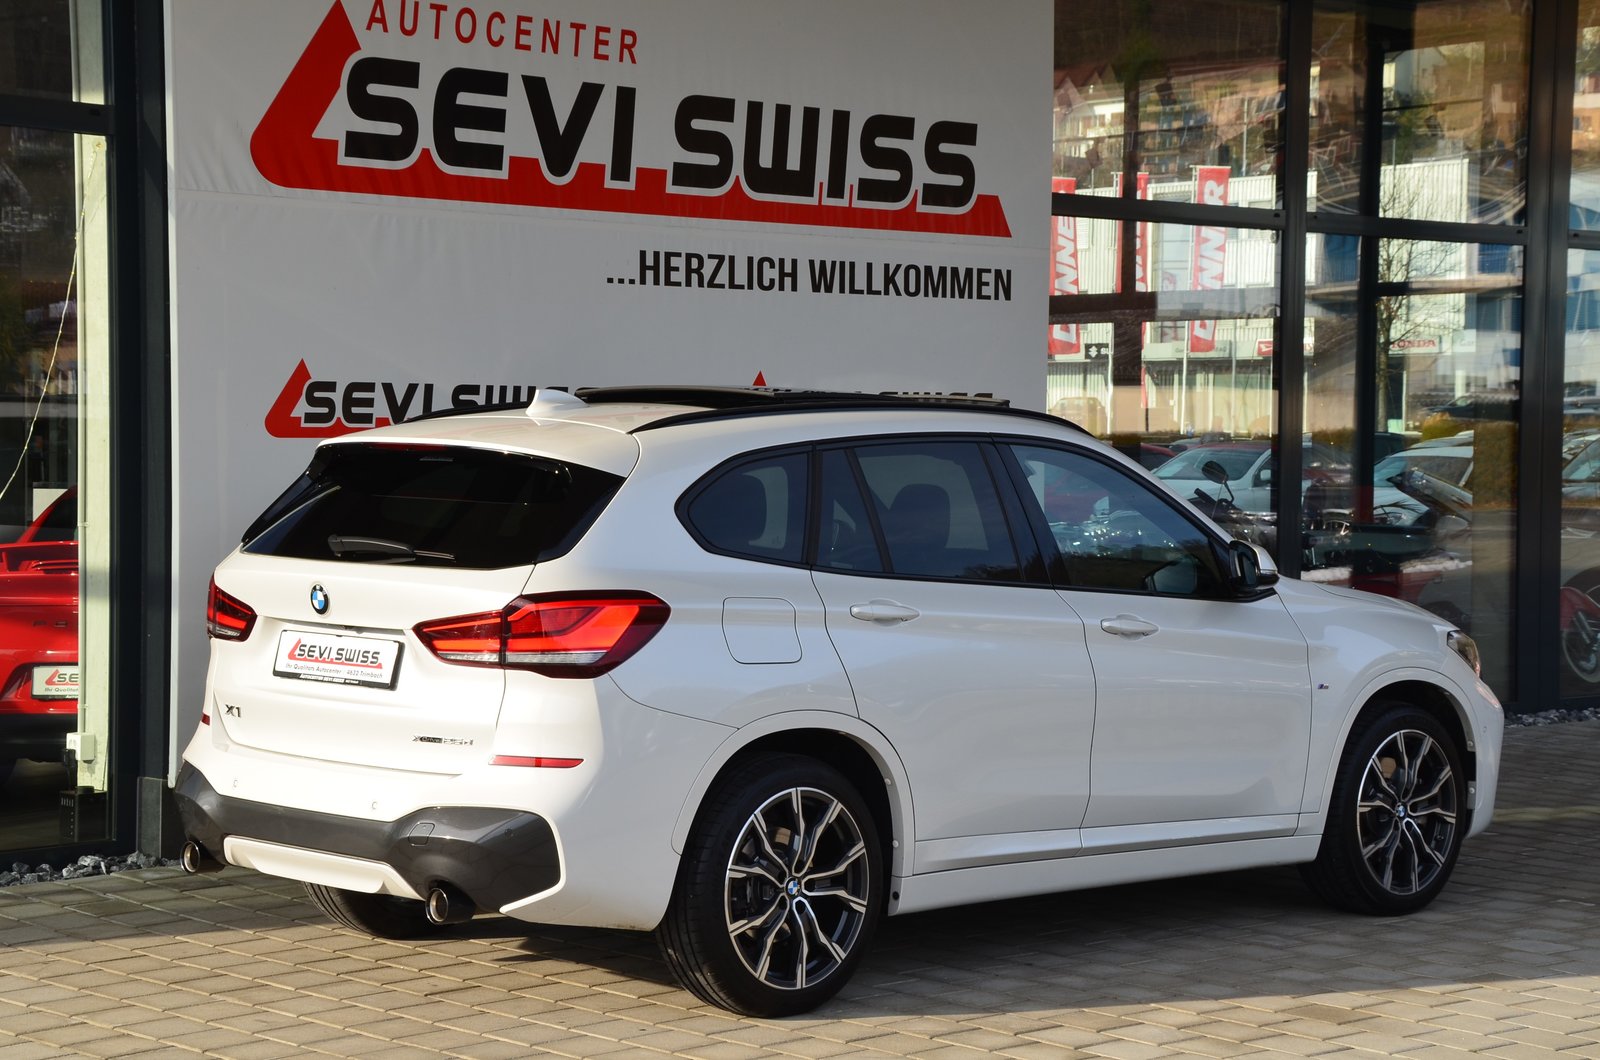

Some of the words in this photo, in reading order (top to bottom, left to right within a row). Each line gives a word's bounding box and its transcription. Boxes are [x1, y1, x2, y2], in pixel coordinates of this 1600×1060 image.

[366, 0, 637, 64] AUTOCENTER
[345, 57, 636, 183] SEVI
[672, 94, 978, 208] SWISS
[606, 250, 798, 292] ...HERZLICH
[808, 259, 1012, 301] WILLKOMMEN
[303, 380, 434, 425] SEVI
[297, 644, 332, 661] SEVI
[335, 648, 380, 665] SWISS
[57, 673, 79, 683] SE
[225, 704, 242, 718] X1
